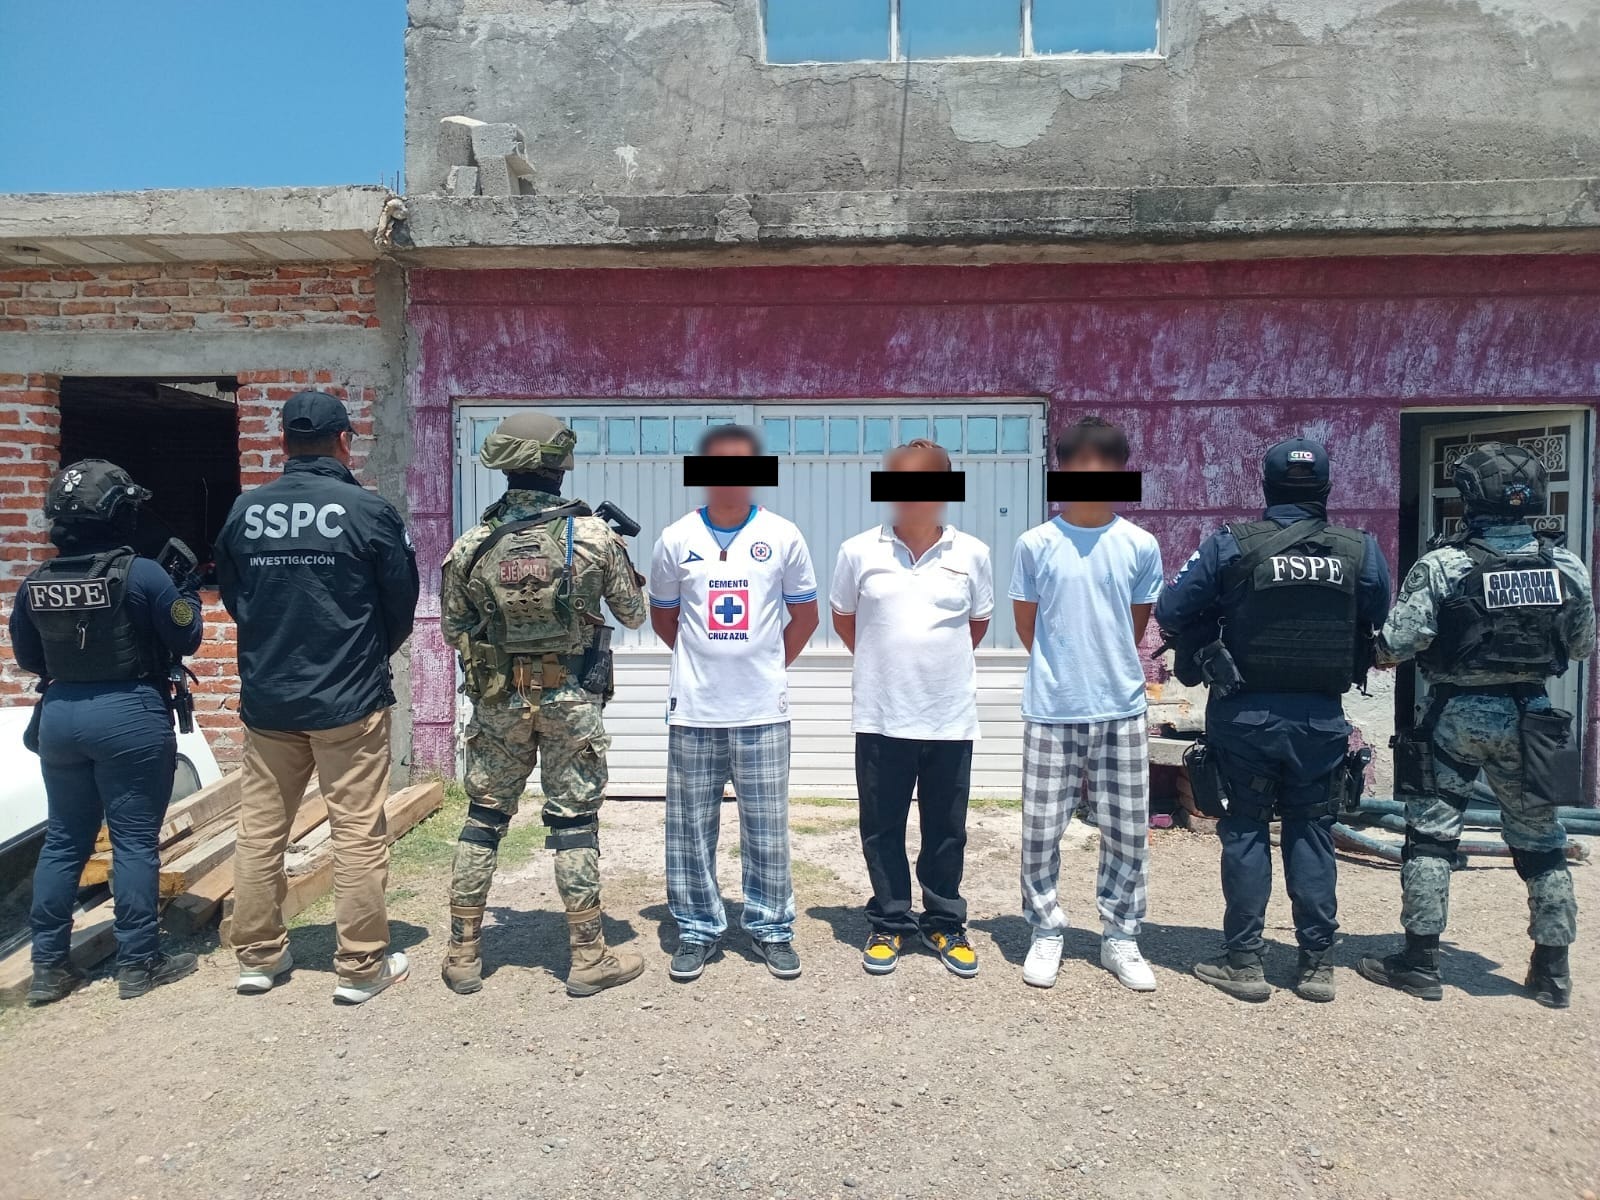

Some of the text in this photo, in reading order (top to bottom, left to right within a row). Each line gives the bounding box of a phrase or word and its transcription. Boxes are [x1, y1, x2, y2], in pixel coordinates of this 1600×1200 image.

[244, 502, 346, 539] SSPC
[249, 554, 335, 566] INVESTIGACIÓN
[1270, 556, 1344, 585] FSPE
[709, 580, 748, 588] CEMENTO
[1489, 571, 1556, 590] GUARDIA
[30, 582, 105, 607] FSPE
[1487, 587, 1560, 607] NACIONAL
[708, 632, 749, 640] CRUZ AZUL
